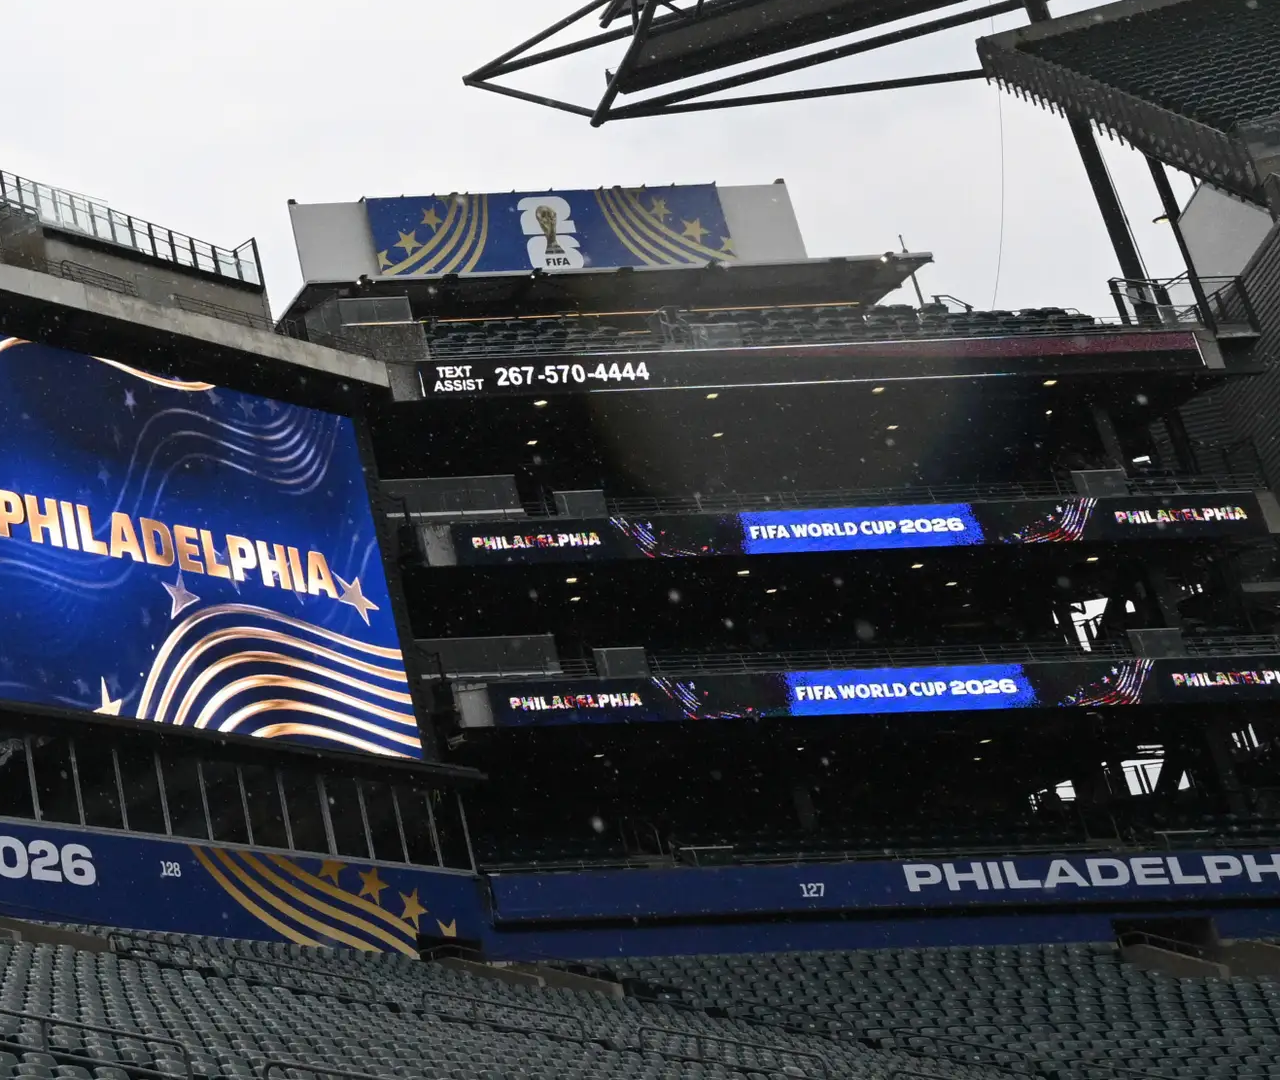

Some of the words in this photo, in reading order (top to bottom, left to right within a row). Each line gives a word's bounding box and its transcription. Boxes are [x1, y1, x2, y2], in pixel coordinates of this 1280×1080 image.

[545, 257, 571, 266] FIFA
[436, 365, 473, 379] TEXT
[494, 361, 650, 387] 267-570-4444
[434, 378, 485, 392] ASSIST
[1114, 506, 1248, 524] PHILADELPHIA
[749, 524, 790, 540] FIFA
[790, 521, 858, 538] WORLD
[860, 520, 897, 535] CUP
[898, 517, 965, 534] 2026
[471, 532, 601, 550] PHILADELPHIA
[794, 685, 837, 701] FIFA
[838, 683, 908, 699] WORLD
[909, 681, 947, 697] CUP
[949, 678, 1018, 695] 2026
[509, 692, 642, 711] PHILADELPHIA
[159, 860, 182, 878] 128
[902, 854, 1280, 892] PHILADELPH
[799, 882, 825, 898] 127
